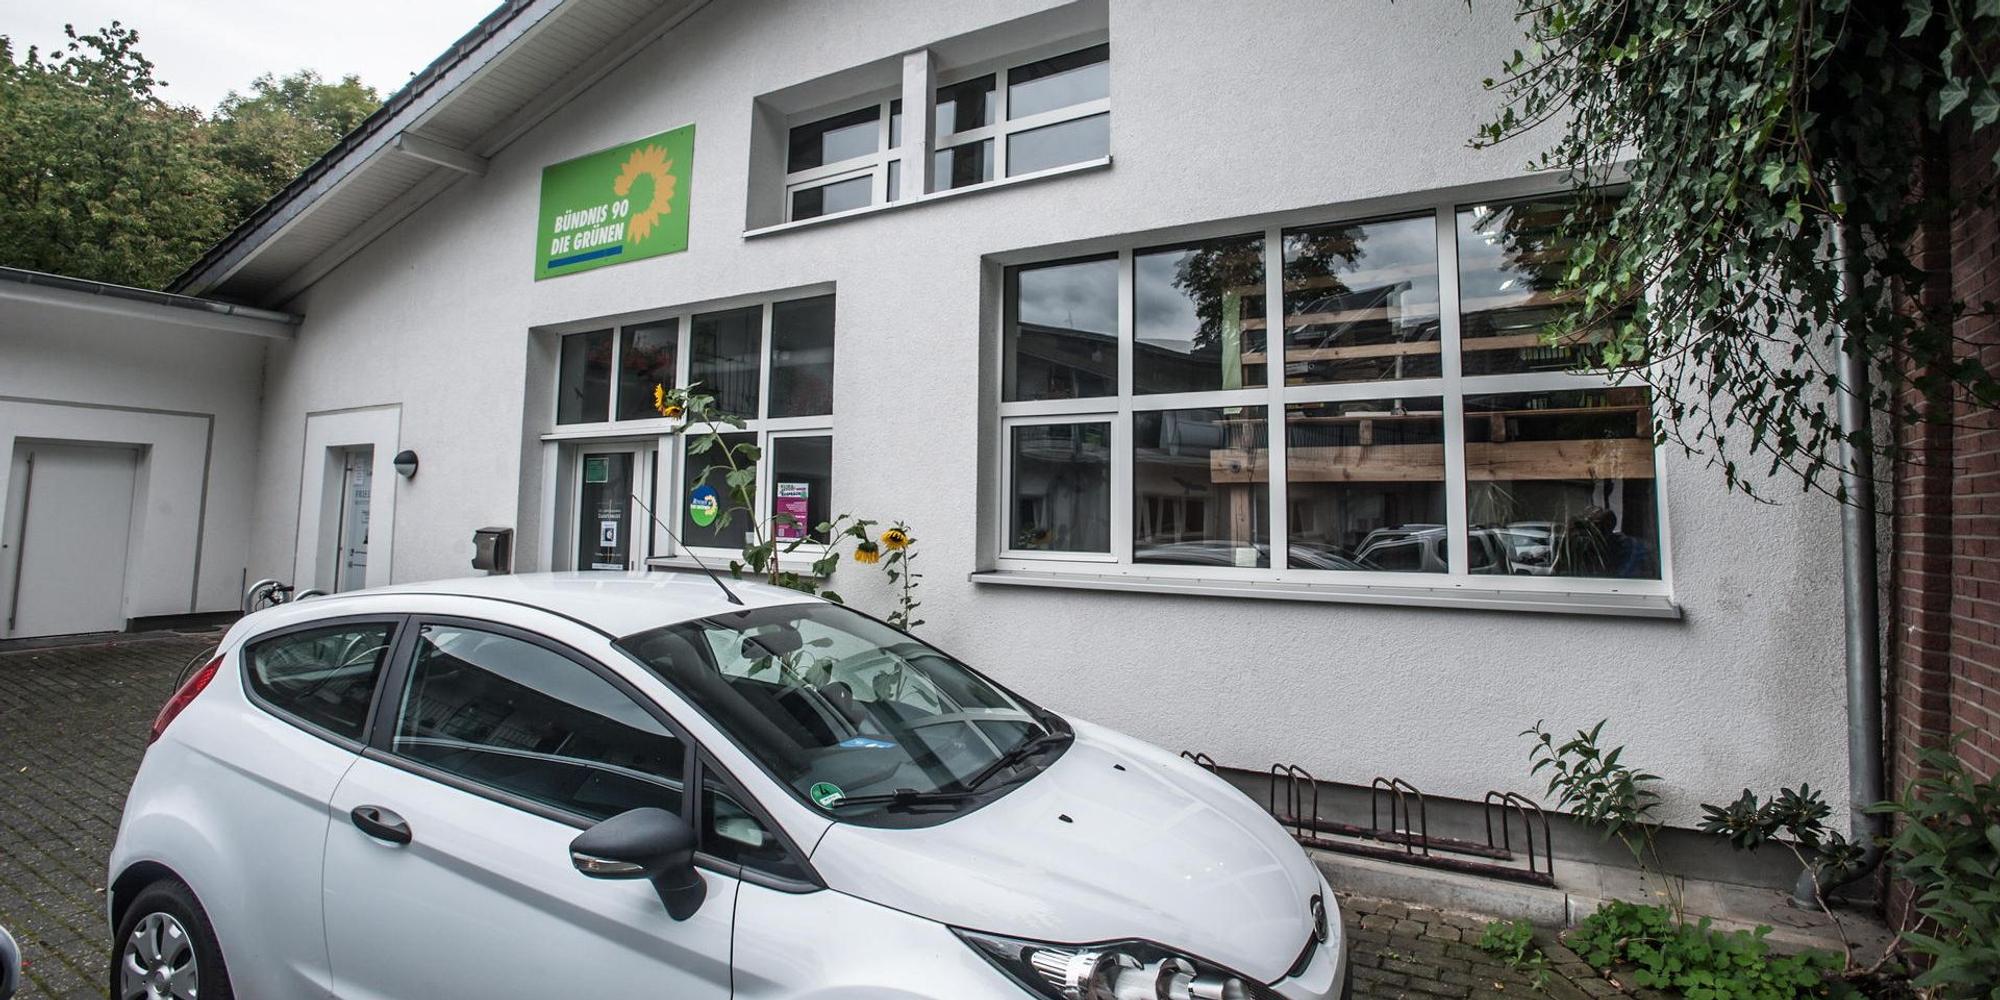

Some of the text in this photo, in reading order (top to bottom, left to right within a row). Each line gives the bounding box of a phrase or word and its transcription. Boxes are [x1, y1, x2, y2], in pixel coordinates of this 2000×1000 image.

[554, 199, 630, 233] BÜNDNIS 90
[551, 222, 625, 256] DIE GRÜNEN
[818, 784, 831, 796] 4
